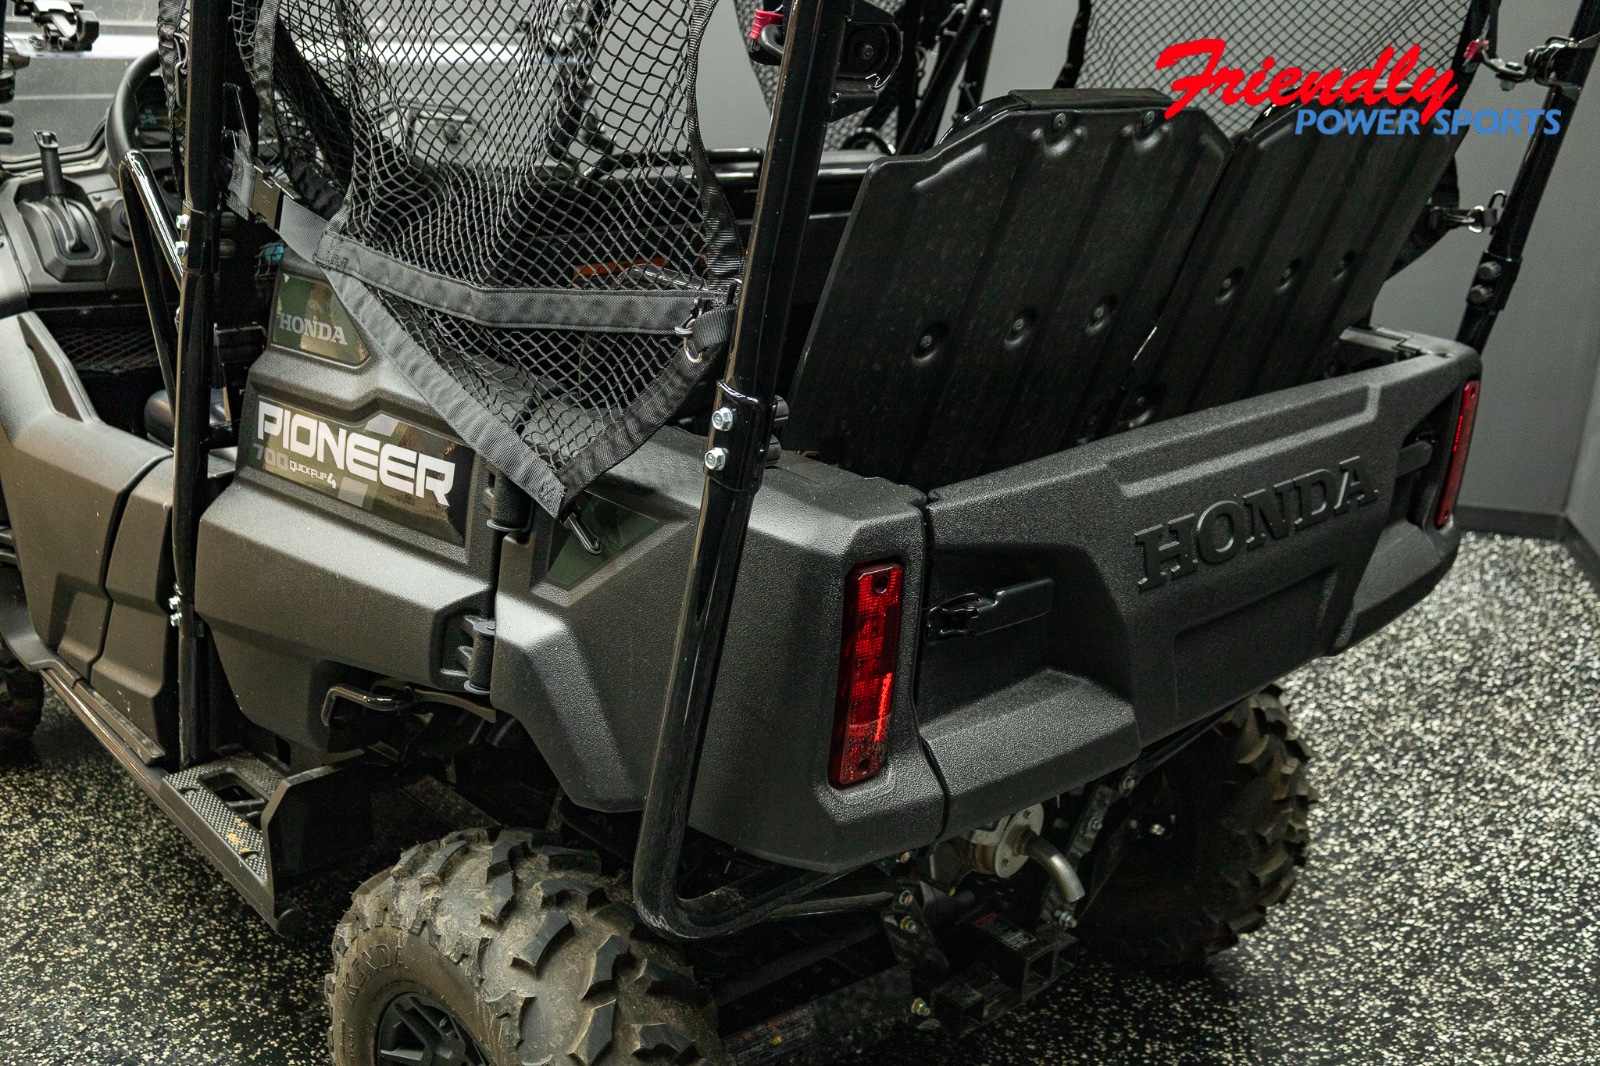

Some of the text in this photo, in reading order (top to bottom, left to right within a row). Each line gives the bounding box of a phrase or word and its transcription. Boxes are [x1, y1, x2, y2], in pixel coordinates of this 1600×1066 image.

[279, 312, 348, 346] HONDA
[253, 442, 289, 471] 700
[258, 401, 456, 507] PIONEER
[1134, 455, 1378, 593] HONDA
